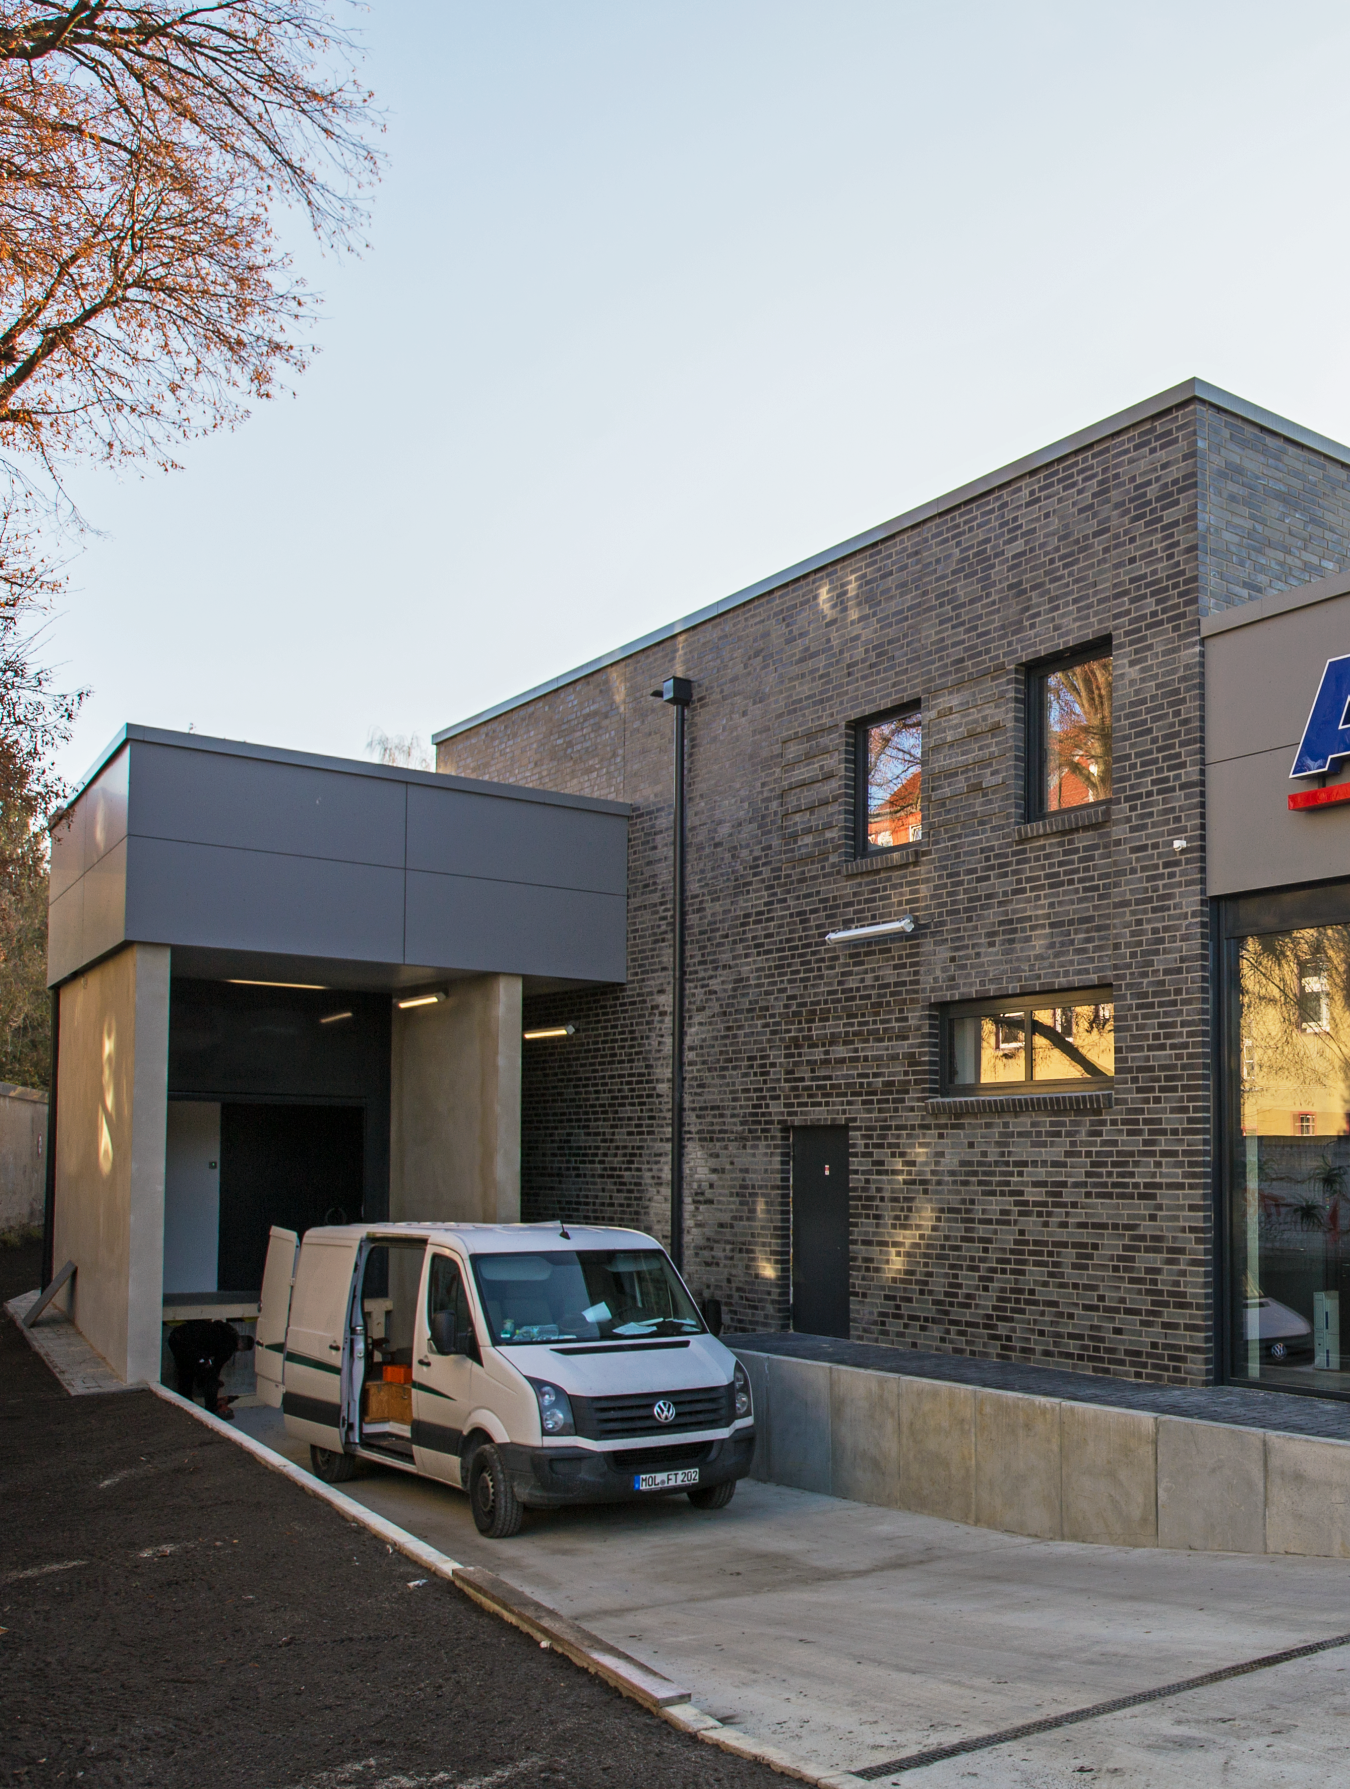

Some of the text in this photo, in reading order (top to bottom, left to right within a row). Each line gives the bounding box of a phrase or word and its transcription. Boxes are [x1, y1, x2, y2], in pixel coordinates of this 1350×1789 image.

[641, 1475, 660, 1488] MOL
[666, 1472, 679, 1484] FT
[680, 1470, 698, 1483] 202
